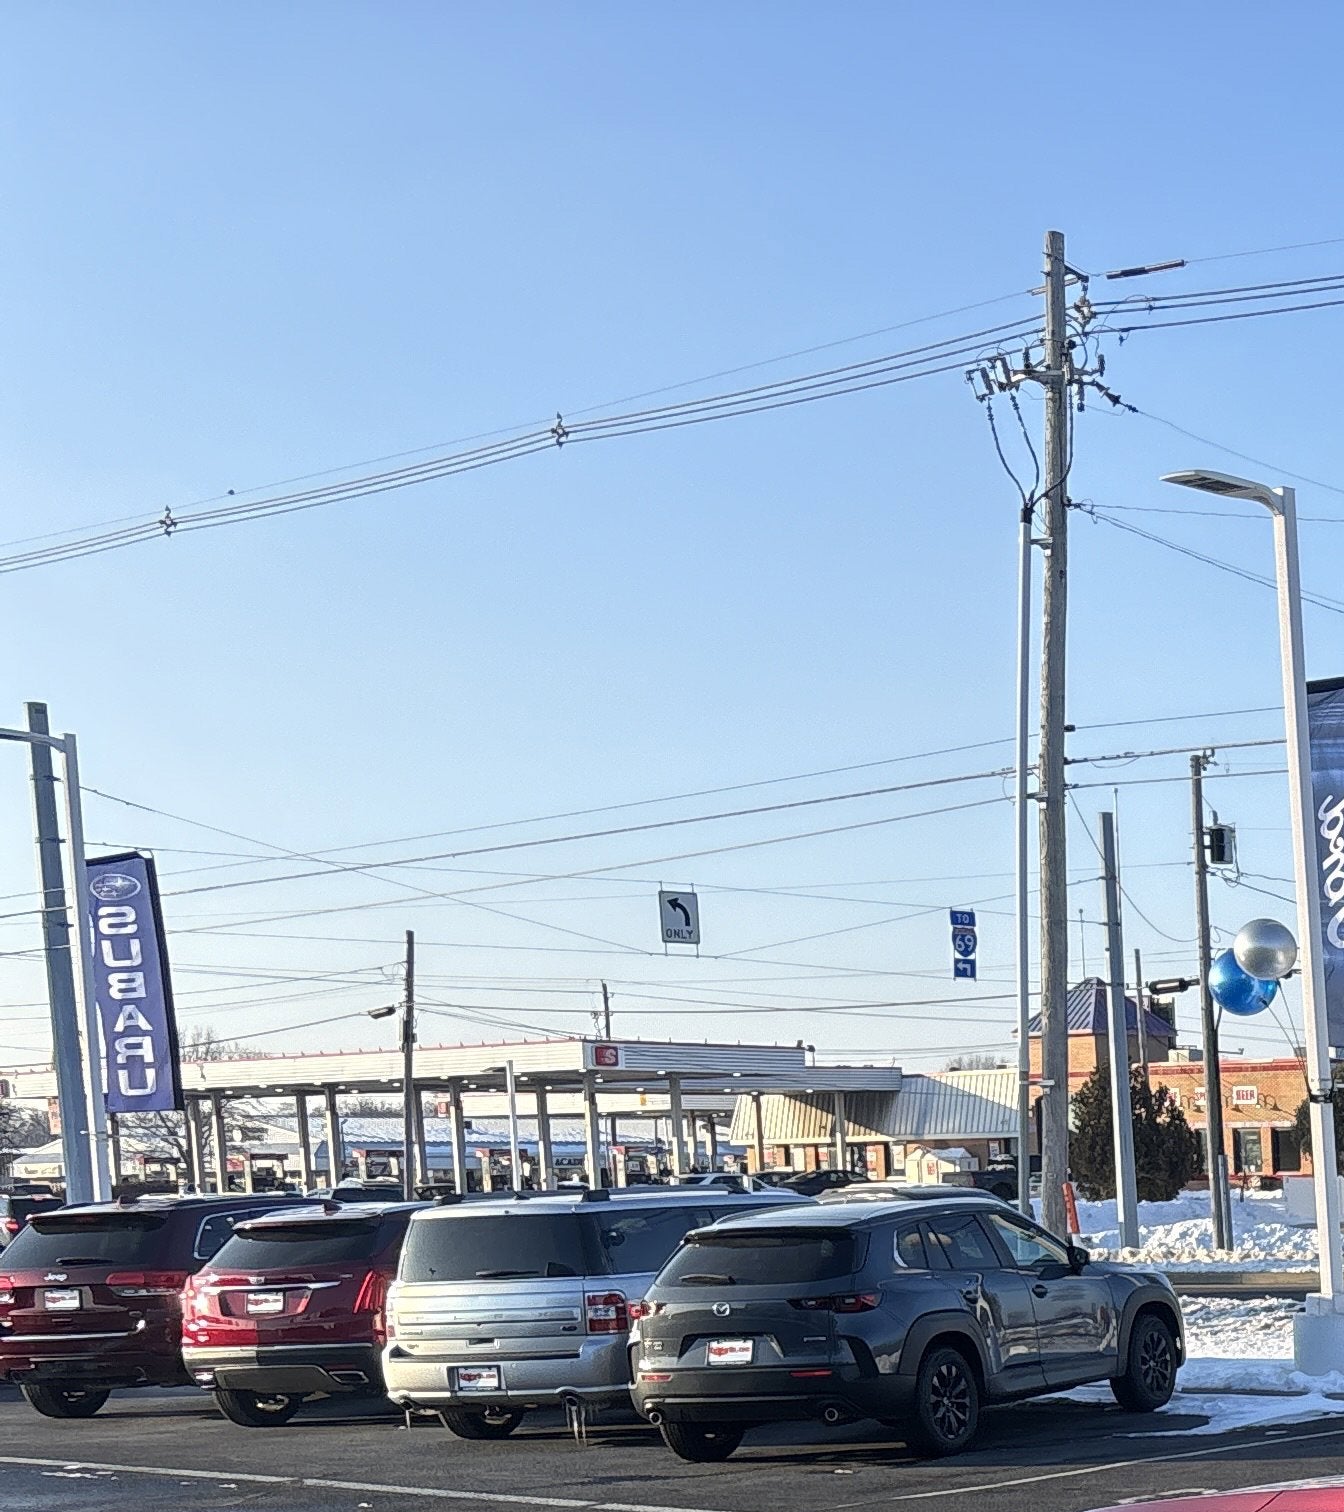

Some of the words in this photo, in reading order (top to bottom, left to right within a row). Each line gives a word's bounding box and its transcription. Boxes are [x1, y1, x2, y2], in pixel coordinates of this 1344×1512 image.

[955, 913, 970, 924] TO
[665, 928, 694, 939] ONLY
[955, 934, 974, 952] 69
[1235, 1089, 1255, 1101] BEER
